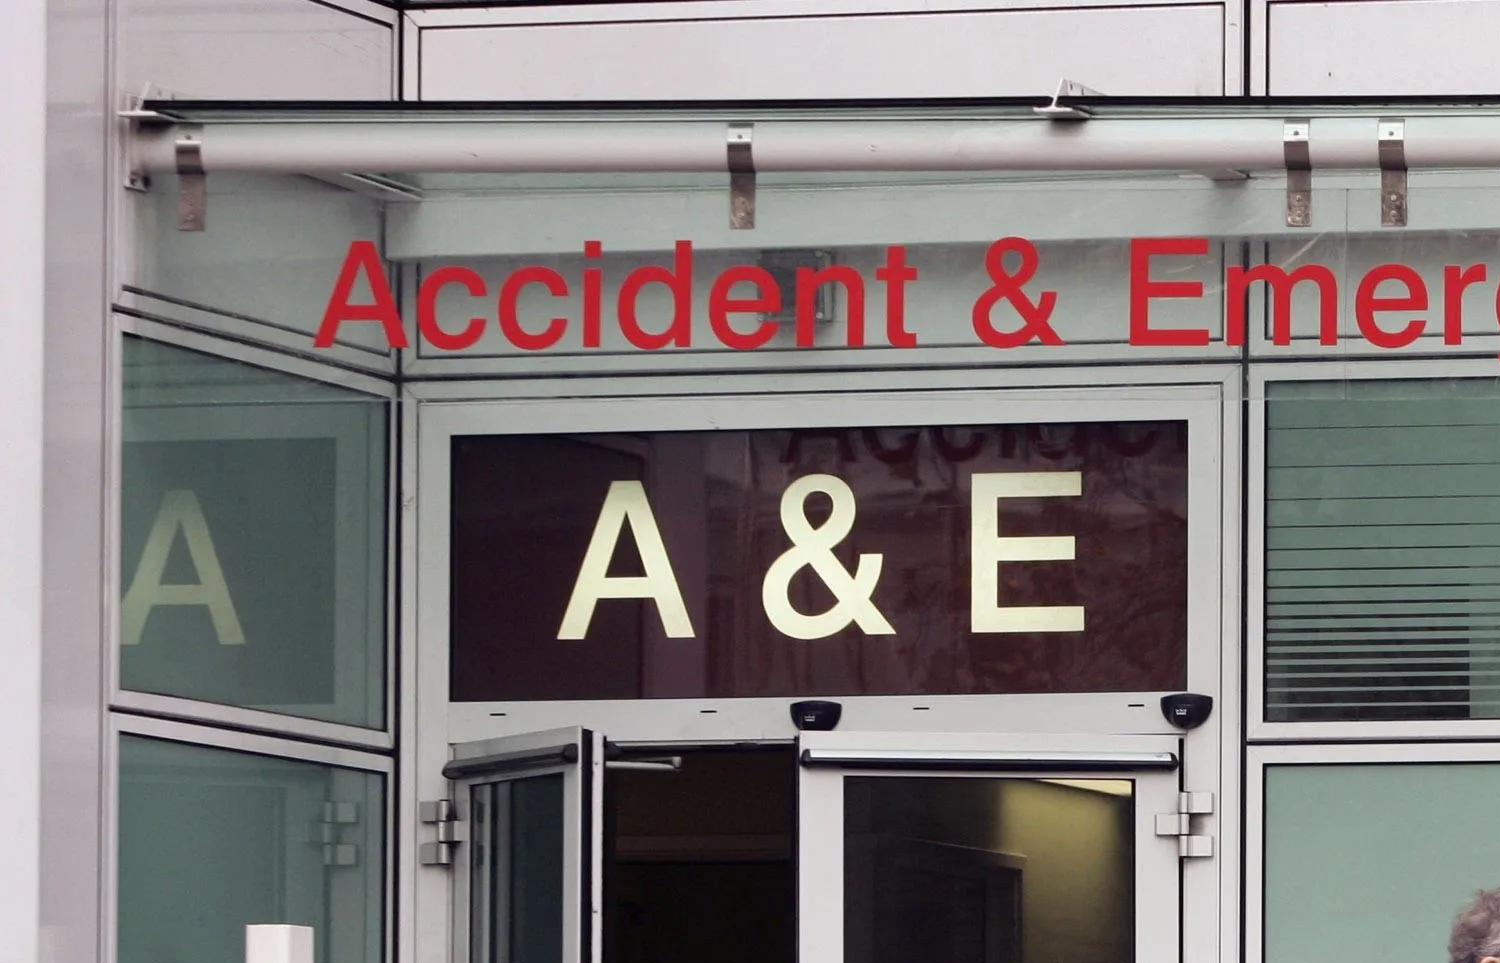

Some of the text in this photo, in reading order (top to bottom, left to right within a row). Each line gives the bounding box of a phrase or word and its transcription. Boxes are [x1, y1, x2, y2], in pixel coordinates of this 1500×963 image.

[314, 239, 918, 350] Accident
[972, 237, 1064, 349] &
[557, 471, 1086, 640] A & E
